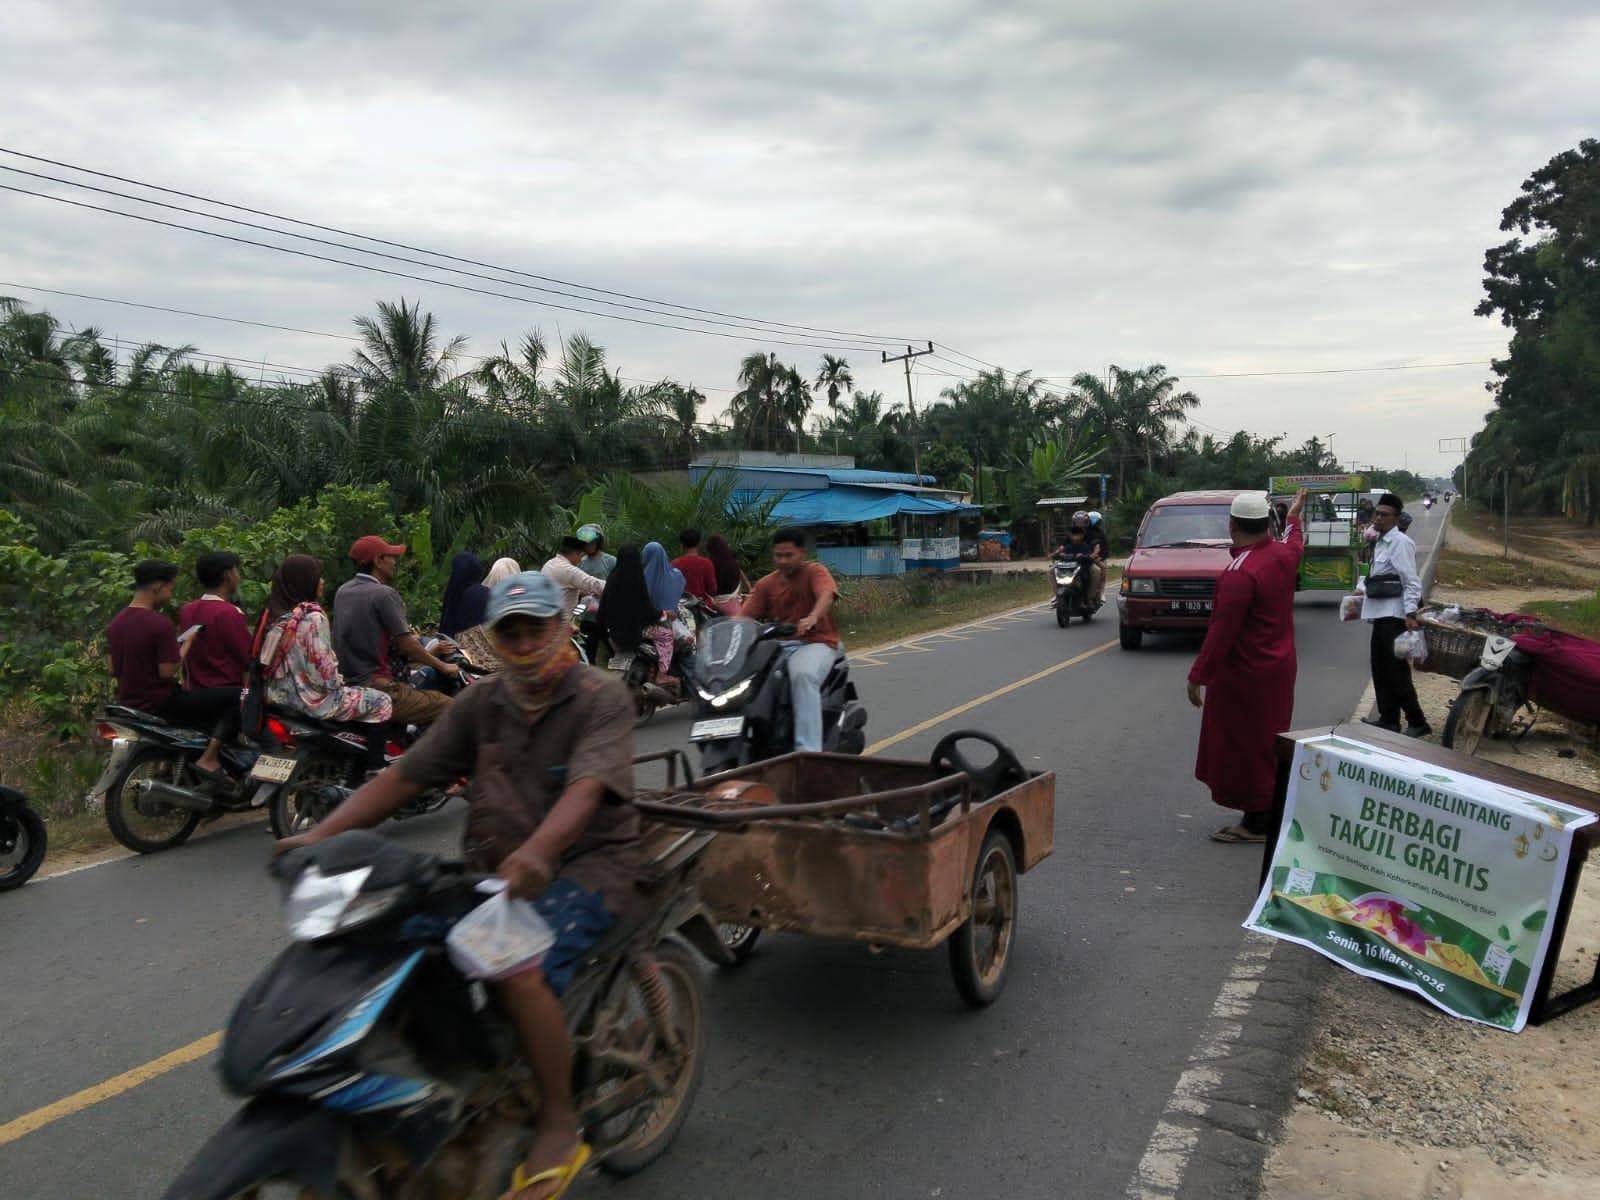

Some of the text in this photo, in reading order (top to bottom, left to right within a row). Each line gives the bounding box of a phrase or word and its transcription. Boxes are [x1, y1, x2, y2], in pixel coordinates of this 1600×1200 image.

[1337, 761, 1512, 831] KUA RIMBA MELINTANG
[1360, 797, 1462, 853] BERBAGI
[1329, 813, 1489, 892] TAKJIL GRATIS
[1326, 930, 1362, 954] Senin,
[1365, 943, 1378, 958] 16
[1414, 969, 1447, 993] 2026
